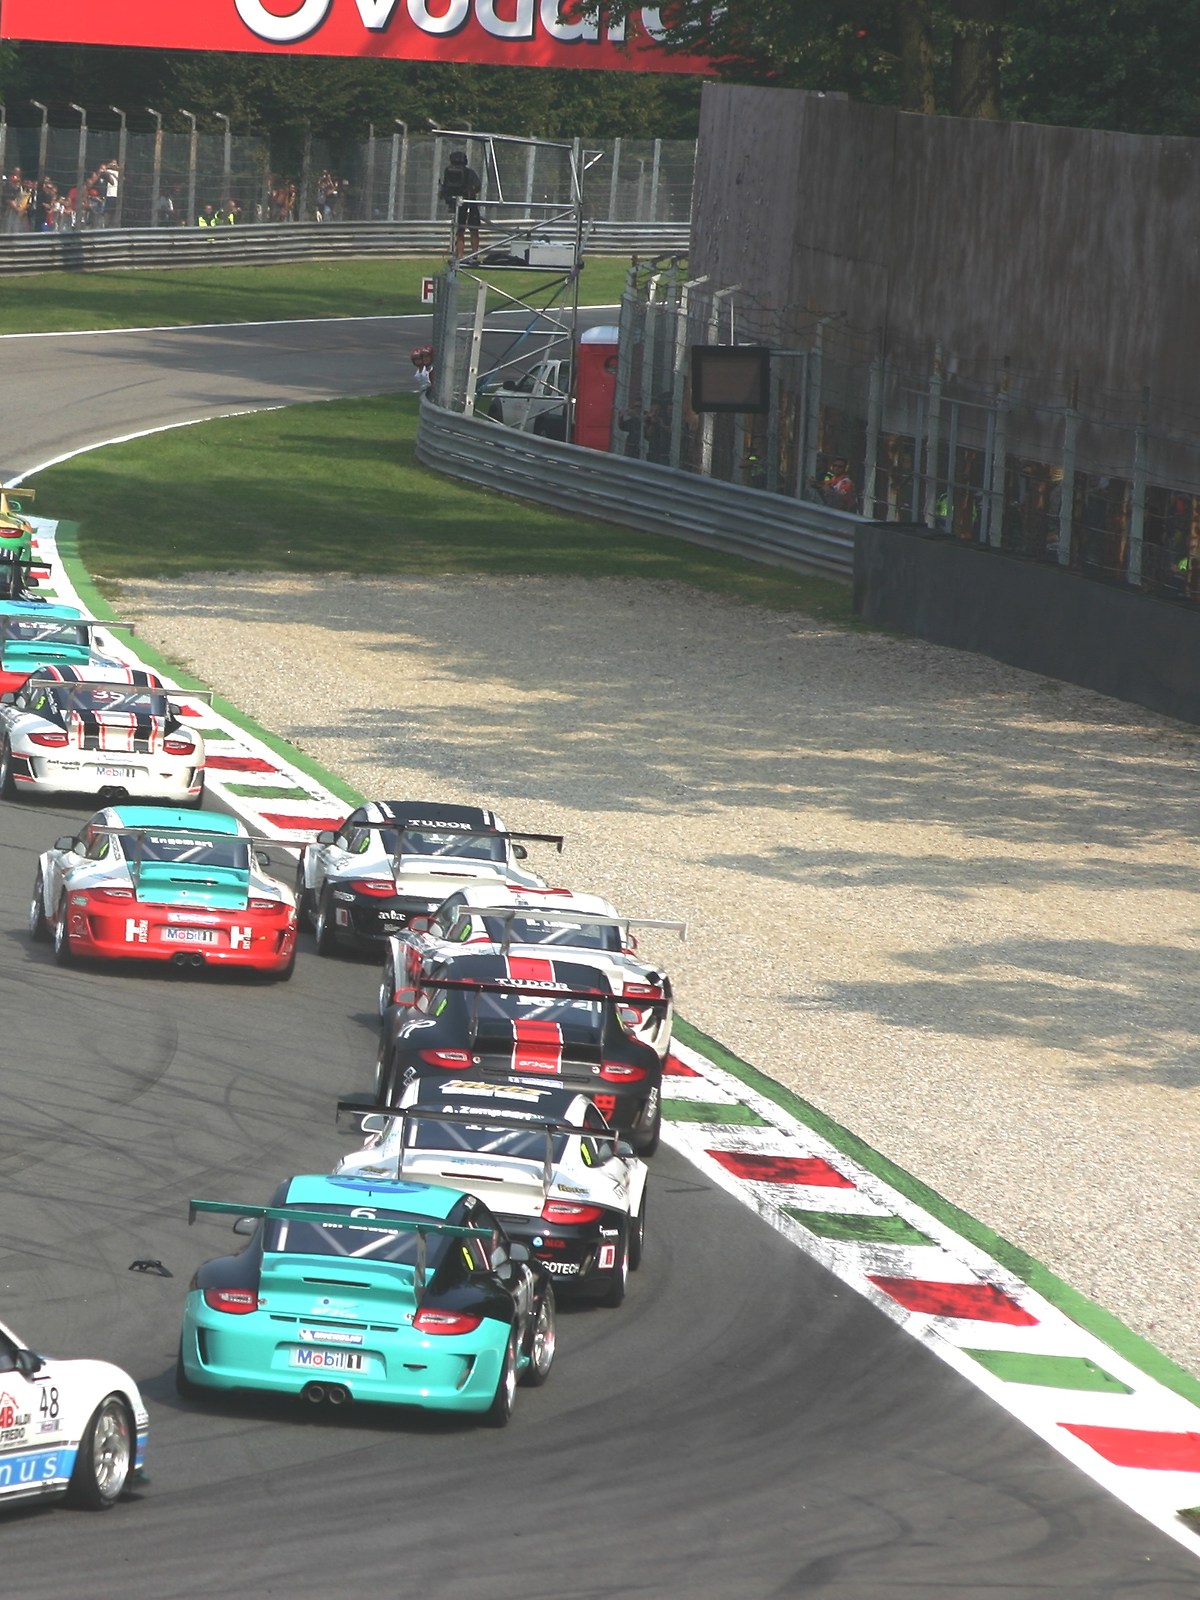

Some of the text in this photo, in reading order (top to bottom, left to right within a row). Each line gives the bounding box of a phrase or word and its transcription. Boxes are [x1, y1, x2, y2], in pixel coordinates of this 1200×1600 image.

[97, 767, 124, 777] Mobil
[167, 928, 200, 941] Mobil
[297, 1349, 344, 1368] Mobil
[39, 1386, 59, 1418] 48
